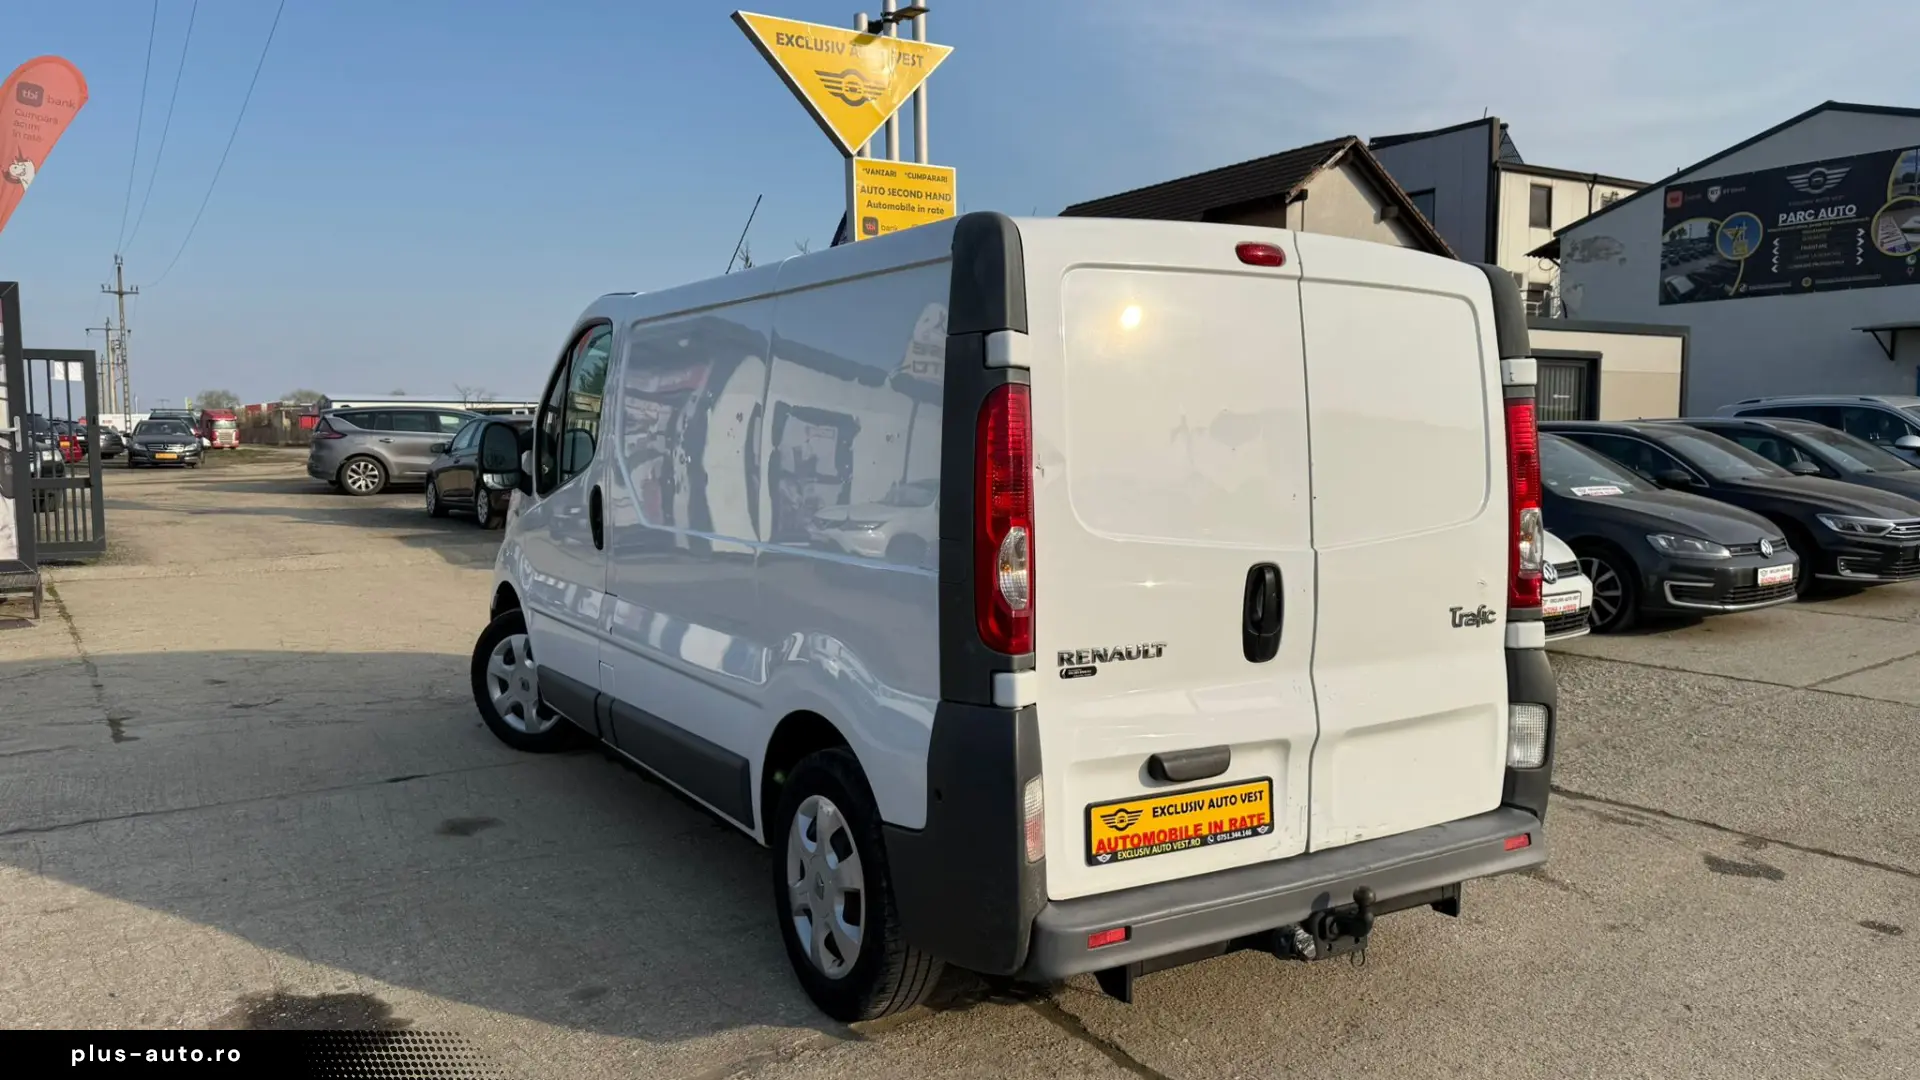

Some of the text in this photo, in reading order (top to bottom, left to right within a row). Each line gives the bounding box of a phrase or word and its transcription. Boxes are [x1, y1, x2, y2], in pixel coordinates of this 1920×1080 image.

[775, 32, 846, 56] EXCLUSIV
[892, 48, 924, 68] VEST
[21, 89, 75, 109] tbi bank
[860, 185, 952, 202] AUTO SECOND HAND
[866, 199, 945, 215] Automobile in rate
[1778, 209, 1816, 225] PARC
[1818, 204, 1857, 219] AUTO
[1449, 604, 1497, 628] Trafic
[1057, 641, 1167, 667] RENAULT
[1152, 790, 1264, 818] EXCLUSIV AUTO VEST
[1094, 812, 1266, 854] AUTOMOBILE IN RATE
[1117, 846, 1150, 860] EXCLUSIV
[1151, 843, 1172, 854] AUTO
[1173, 837, 1201, 850] VEST.RO
